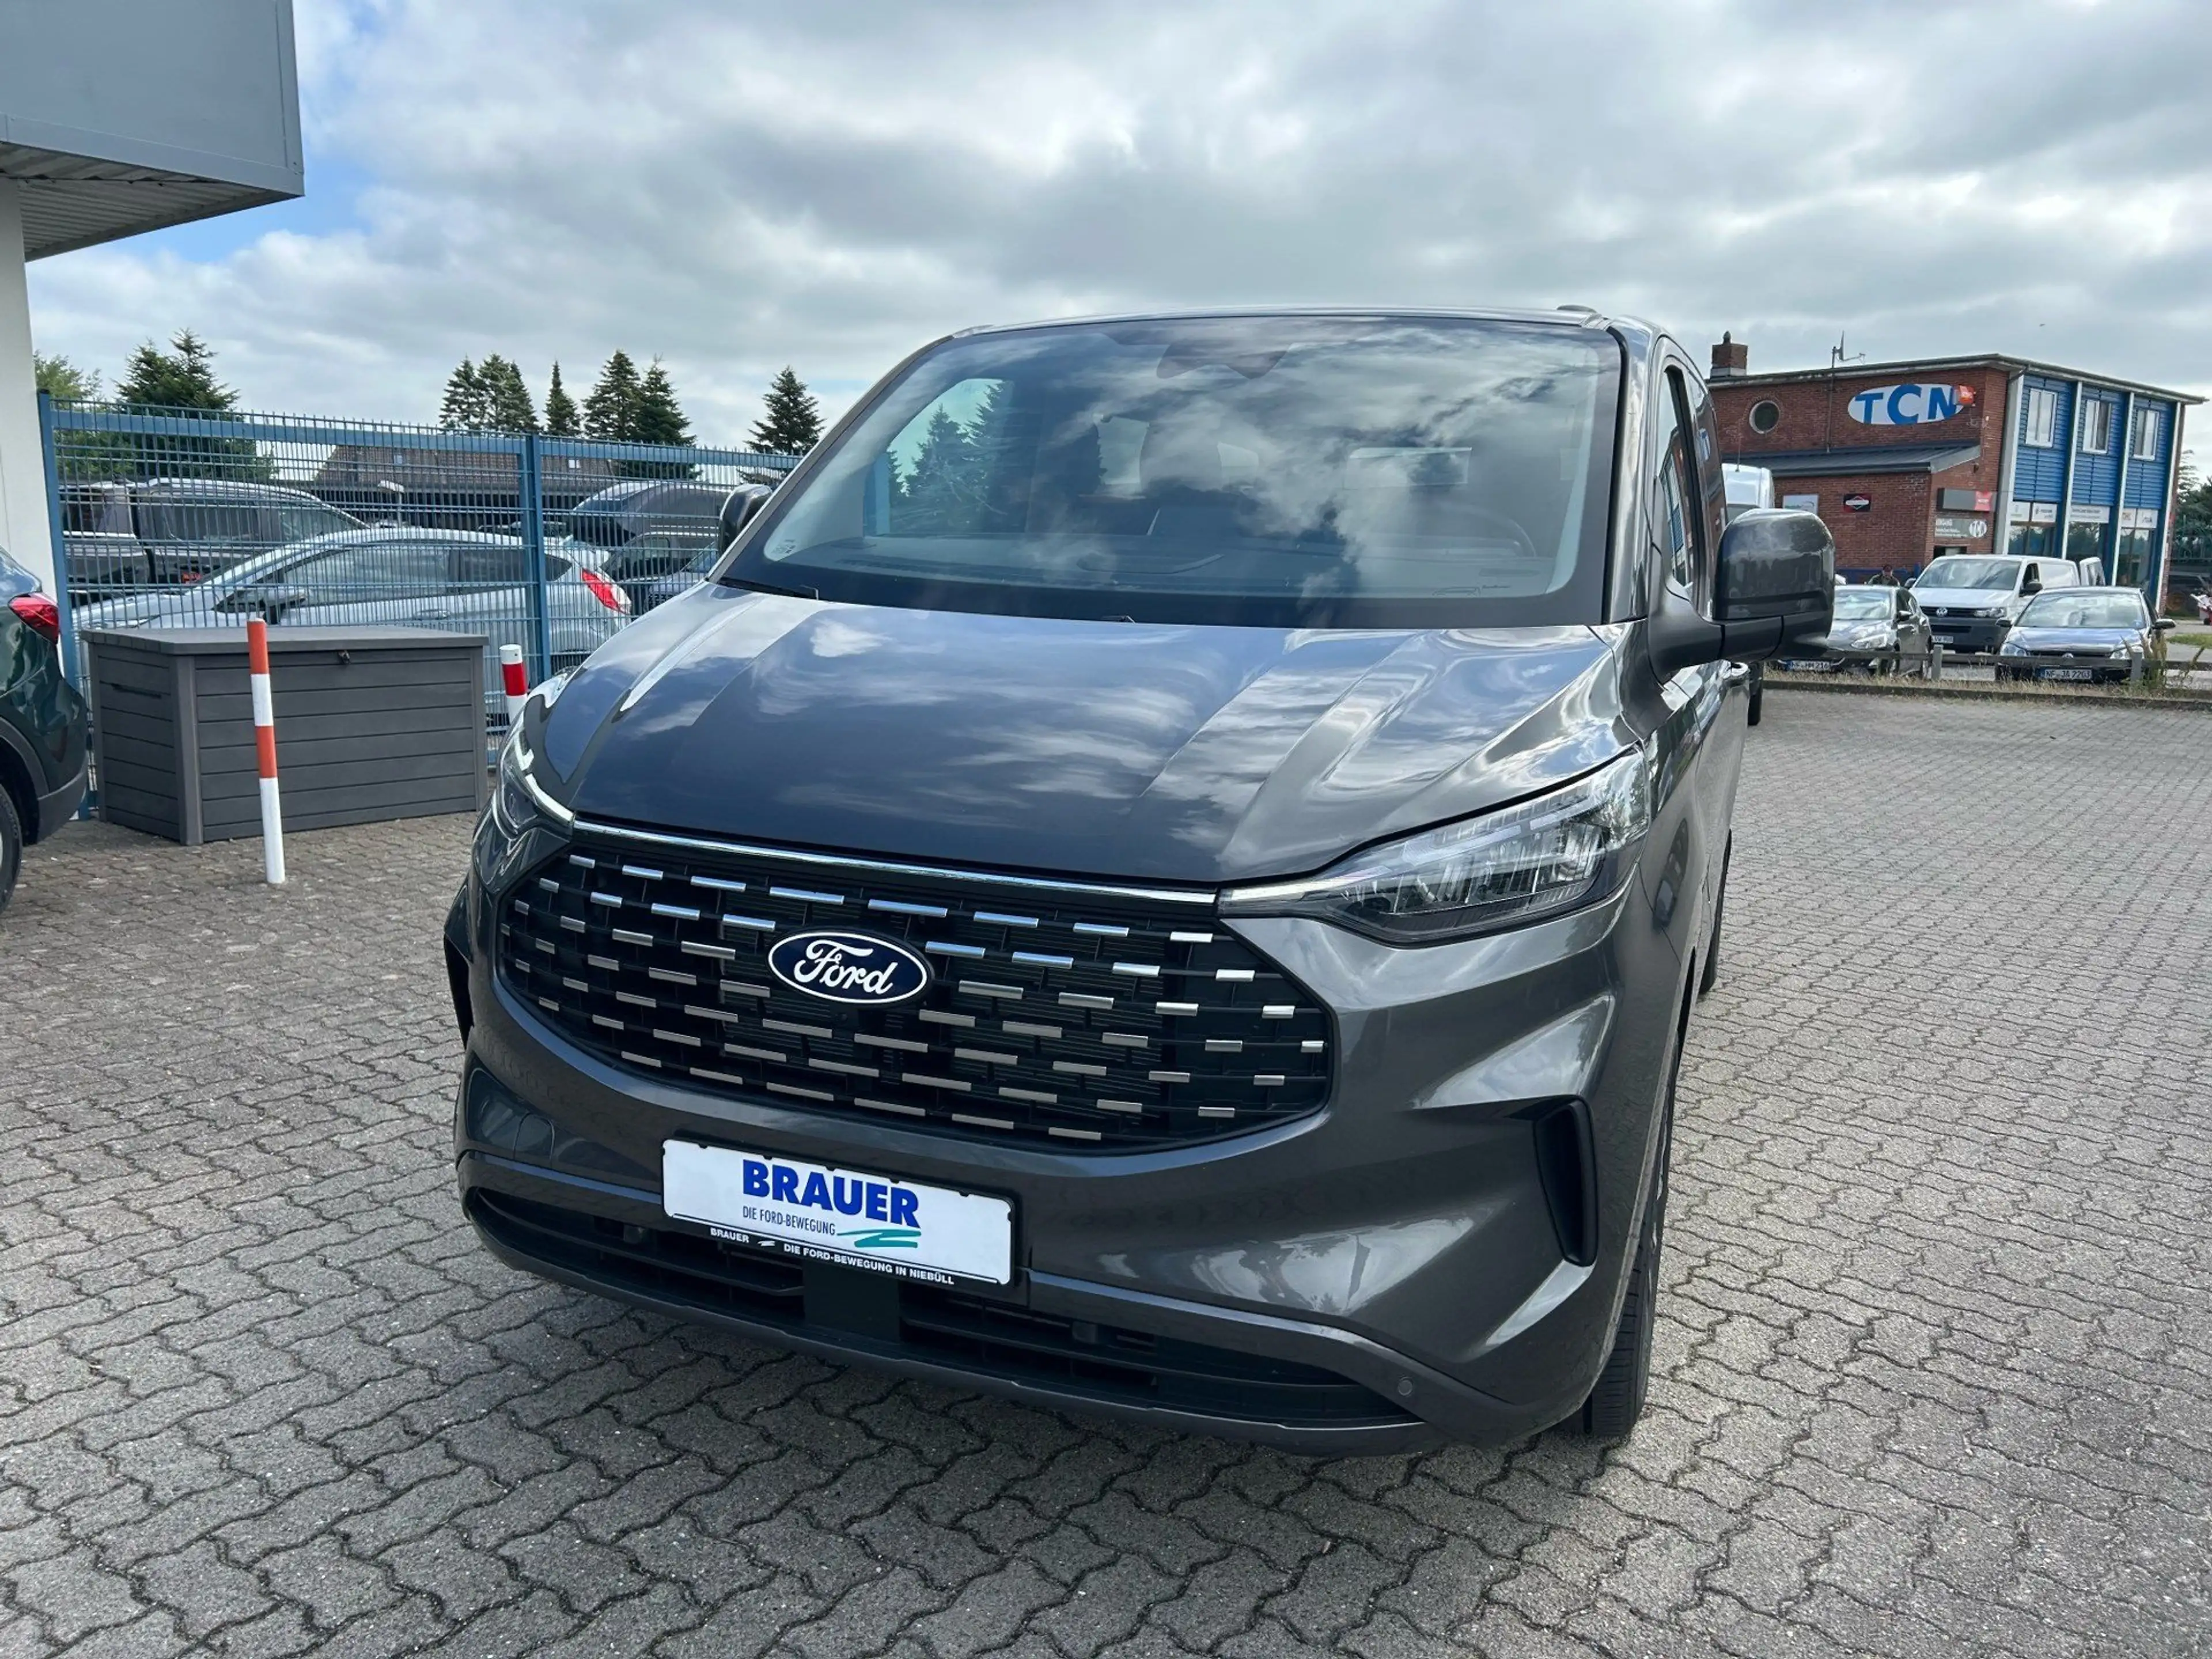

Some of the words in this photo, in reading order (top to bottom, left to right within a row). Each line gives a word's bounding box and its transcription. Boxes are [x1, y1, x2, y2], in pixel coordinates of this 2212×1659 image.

[1855, 384, 1956, 425] TCN
[794, 940, 898, 994] Ford
[743, 1159, 921, 1229] BRAUER
[743, 1206, 757, 1220] DIE
[760, 1209, 835, 1236] FORD-BEWEGUNG
[710, 1227, 749, 1243] BRAUER
[783, 1243, 800, 1255] DIE
[803, 1247, 893, 1274] FORD-BEWEGUNG
[895, 1266, 906, 1276] IN
[910, 1268, 955, 1285] NIEBÜLL
